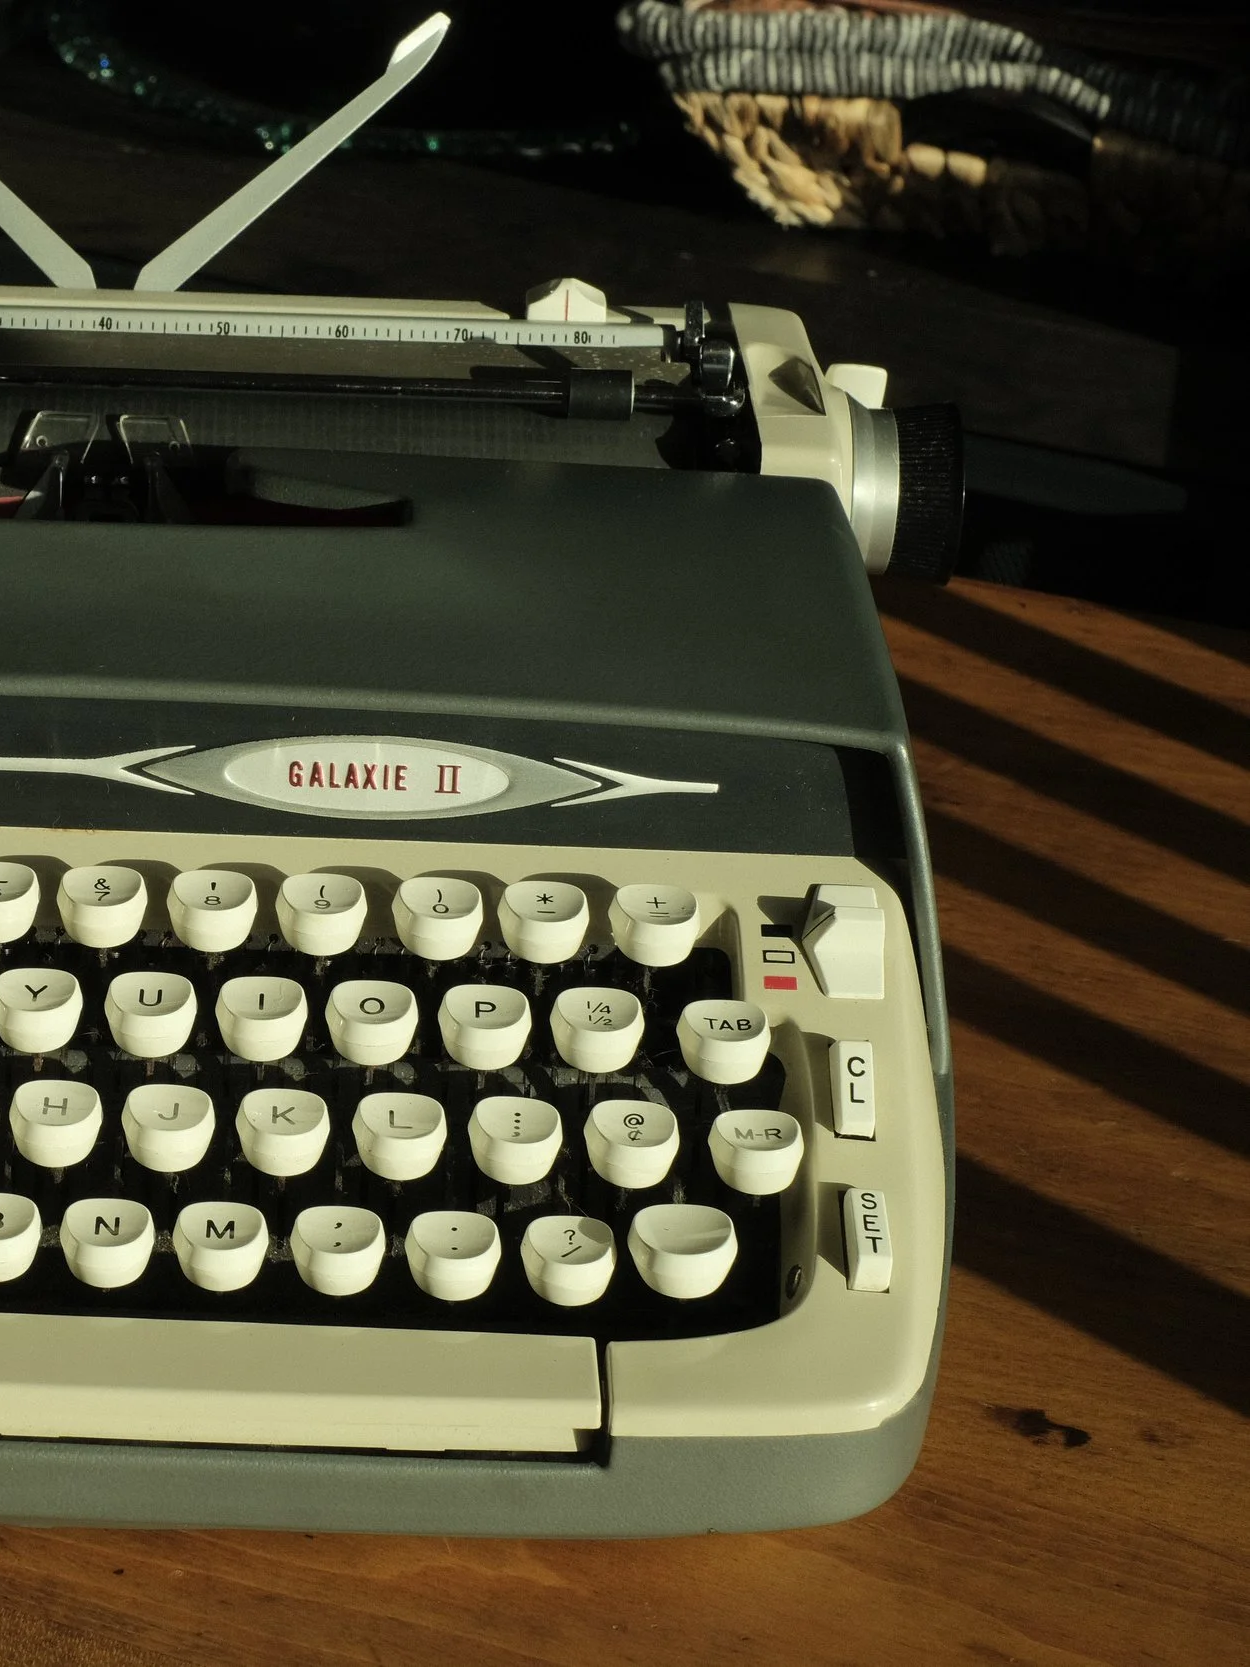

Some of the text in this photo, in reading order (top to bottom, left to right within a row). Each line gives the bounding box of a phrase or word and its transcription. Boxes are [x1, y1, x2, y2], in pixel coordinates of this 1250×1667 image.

[99, 317, 112, 330] 40
[216, 321, 230, 335] 50
[335, 325, 348, 338] 60
[454, 328, 468, 342] 70
[574, 331, 588, 344] 80
[288, 760, 462, 794] GALAXIE II
[94, 877, 111, 891] &
[319, 884, 326, 899] (
[95, 891, 111, 902] 7
[203, 895, 222, 906] 8
[313, 899, 331, 910] 9
[436, 889, 443, 904] )
[645, 896, 667, 909] +
[24, 984, 49, 1002] Y
[138, 988, 163, 1007] U
[258, 992, 265, 1011] I
[359, 997, 386, 1015] O
[474, 1000, 497, 1019] P
[703, 1017, 753, 1033] TAB
[42, 1096, 69, 1117] H
[157, 1102, 180, 1121] J
[271, 1105, 296, 1126] K
[388, 1109, 414, 1129] L
[623, 1113, 645, 1129] @
[627, 1129, 643, 1142] ¢
[734, 1127, 783, 1142] M-R
[94, 1215, 121, 1237] N
[205, 1219, 236, 1240] M
[860, 1192, 883, 1254] SET
[563, 1229, 576, 1246] ?
